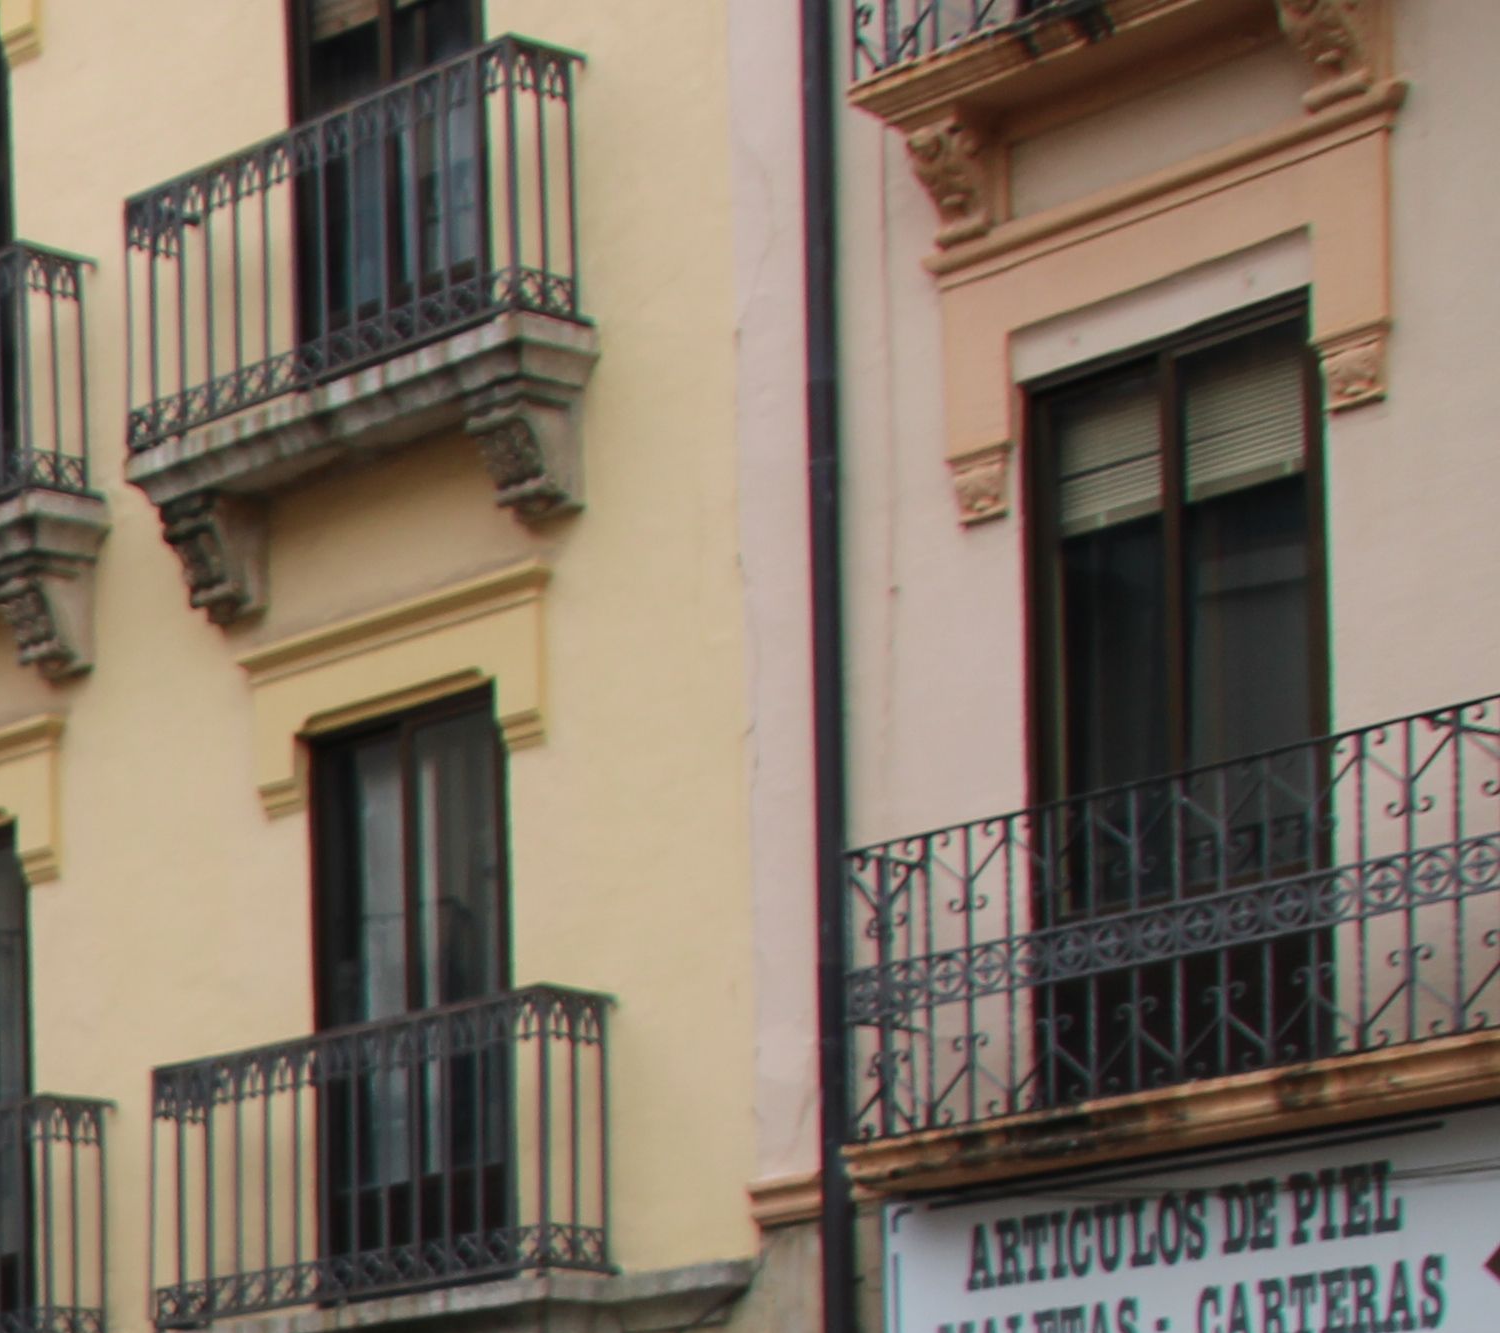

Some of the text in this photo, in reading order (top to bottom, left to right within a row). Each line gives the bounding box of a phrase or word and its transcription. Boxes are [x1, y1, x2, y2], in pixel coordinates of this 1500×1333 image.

[966, 1159, 1406, 1294] ARTICULOS DE PIEL
